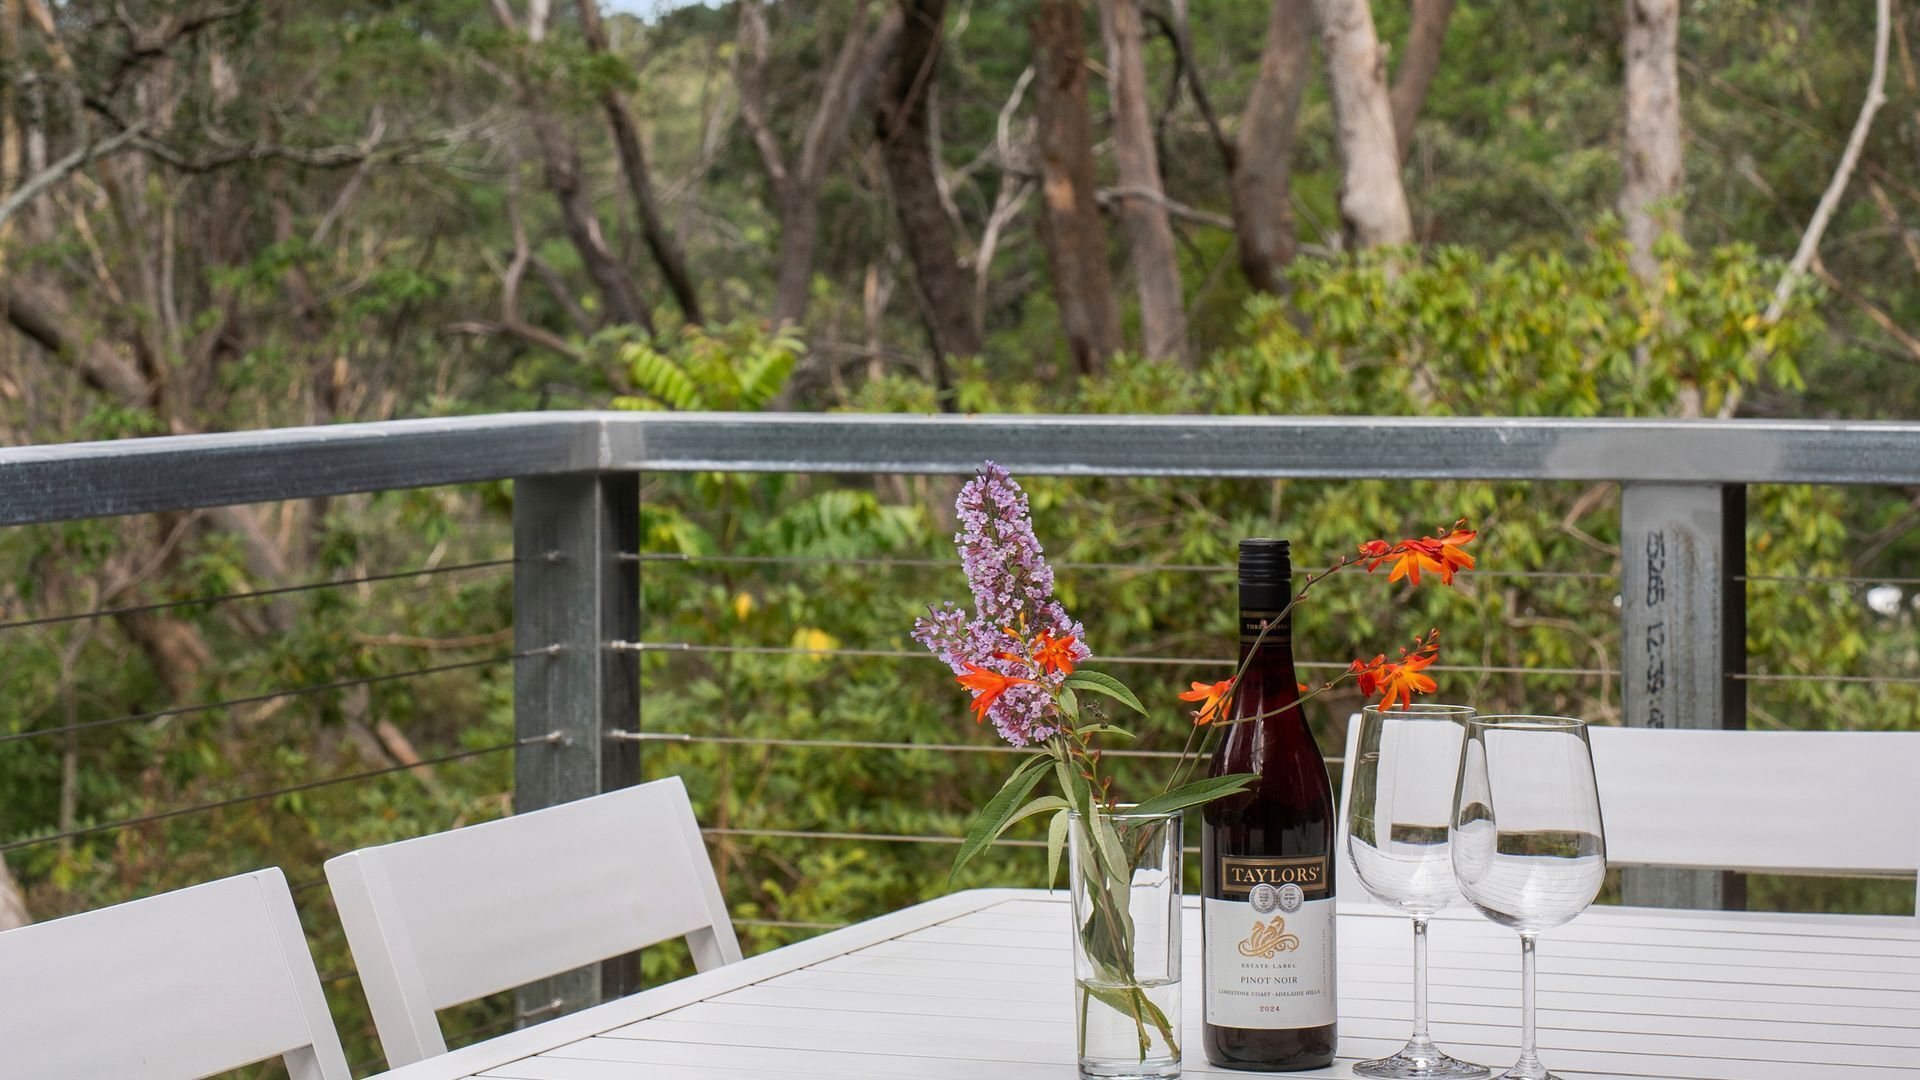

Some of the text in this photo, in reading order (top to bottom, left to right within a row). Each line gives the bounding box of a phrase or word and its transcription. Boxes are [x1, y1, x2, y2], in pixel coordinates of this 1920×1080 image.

[1240, 976, 1298, 985] PINOT NOIR
[1218, 988, 1250, 997] LIMESTONE
